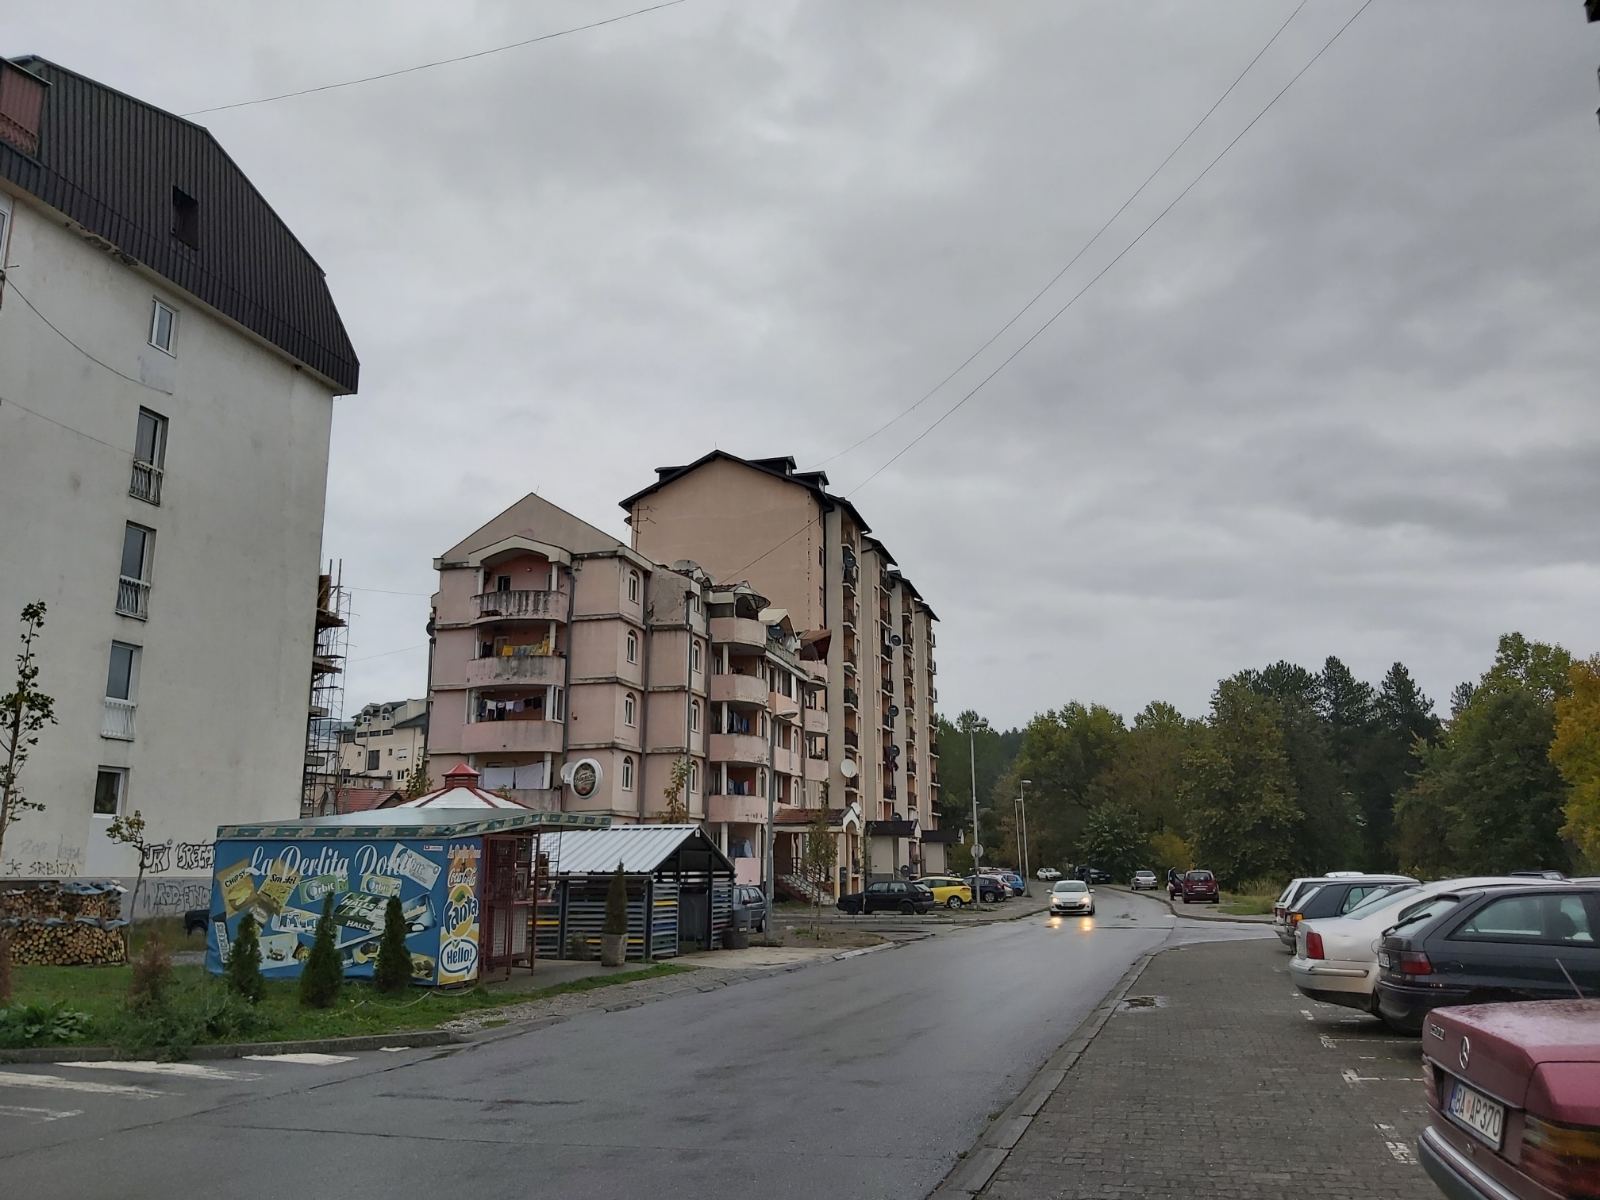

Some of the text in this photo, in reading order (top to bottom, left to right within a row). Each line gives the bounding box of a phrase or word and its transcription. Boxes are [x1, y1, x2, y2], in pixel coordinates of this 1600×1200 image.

[245, 846, 273, 876] La
[341, 898, 377, 911] HALLS
[444, 896, 478, 935] Fanta
[346, 920, 371, 931] HALLS
[447, 947, 472, 965] Hello!
